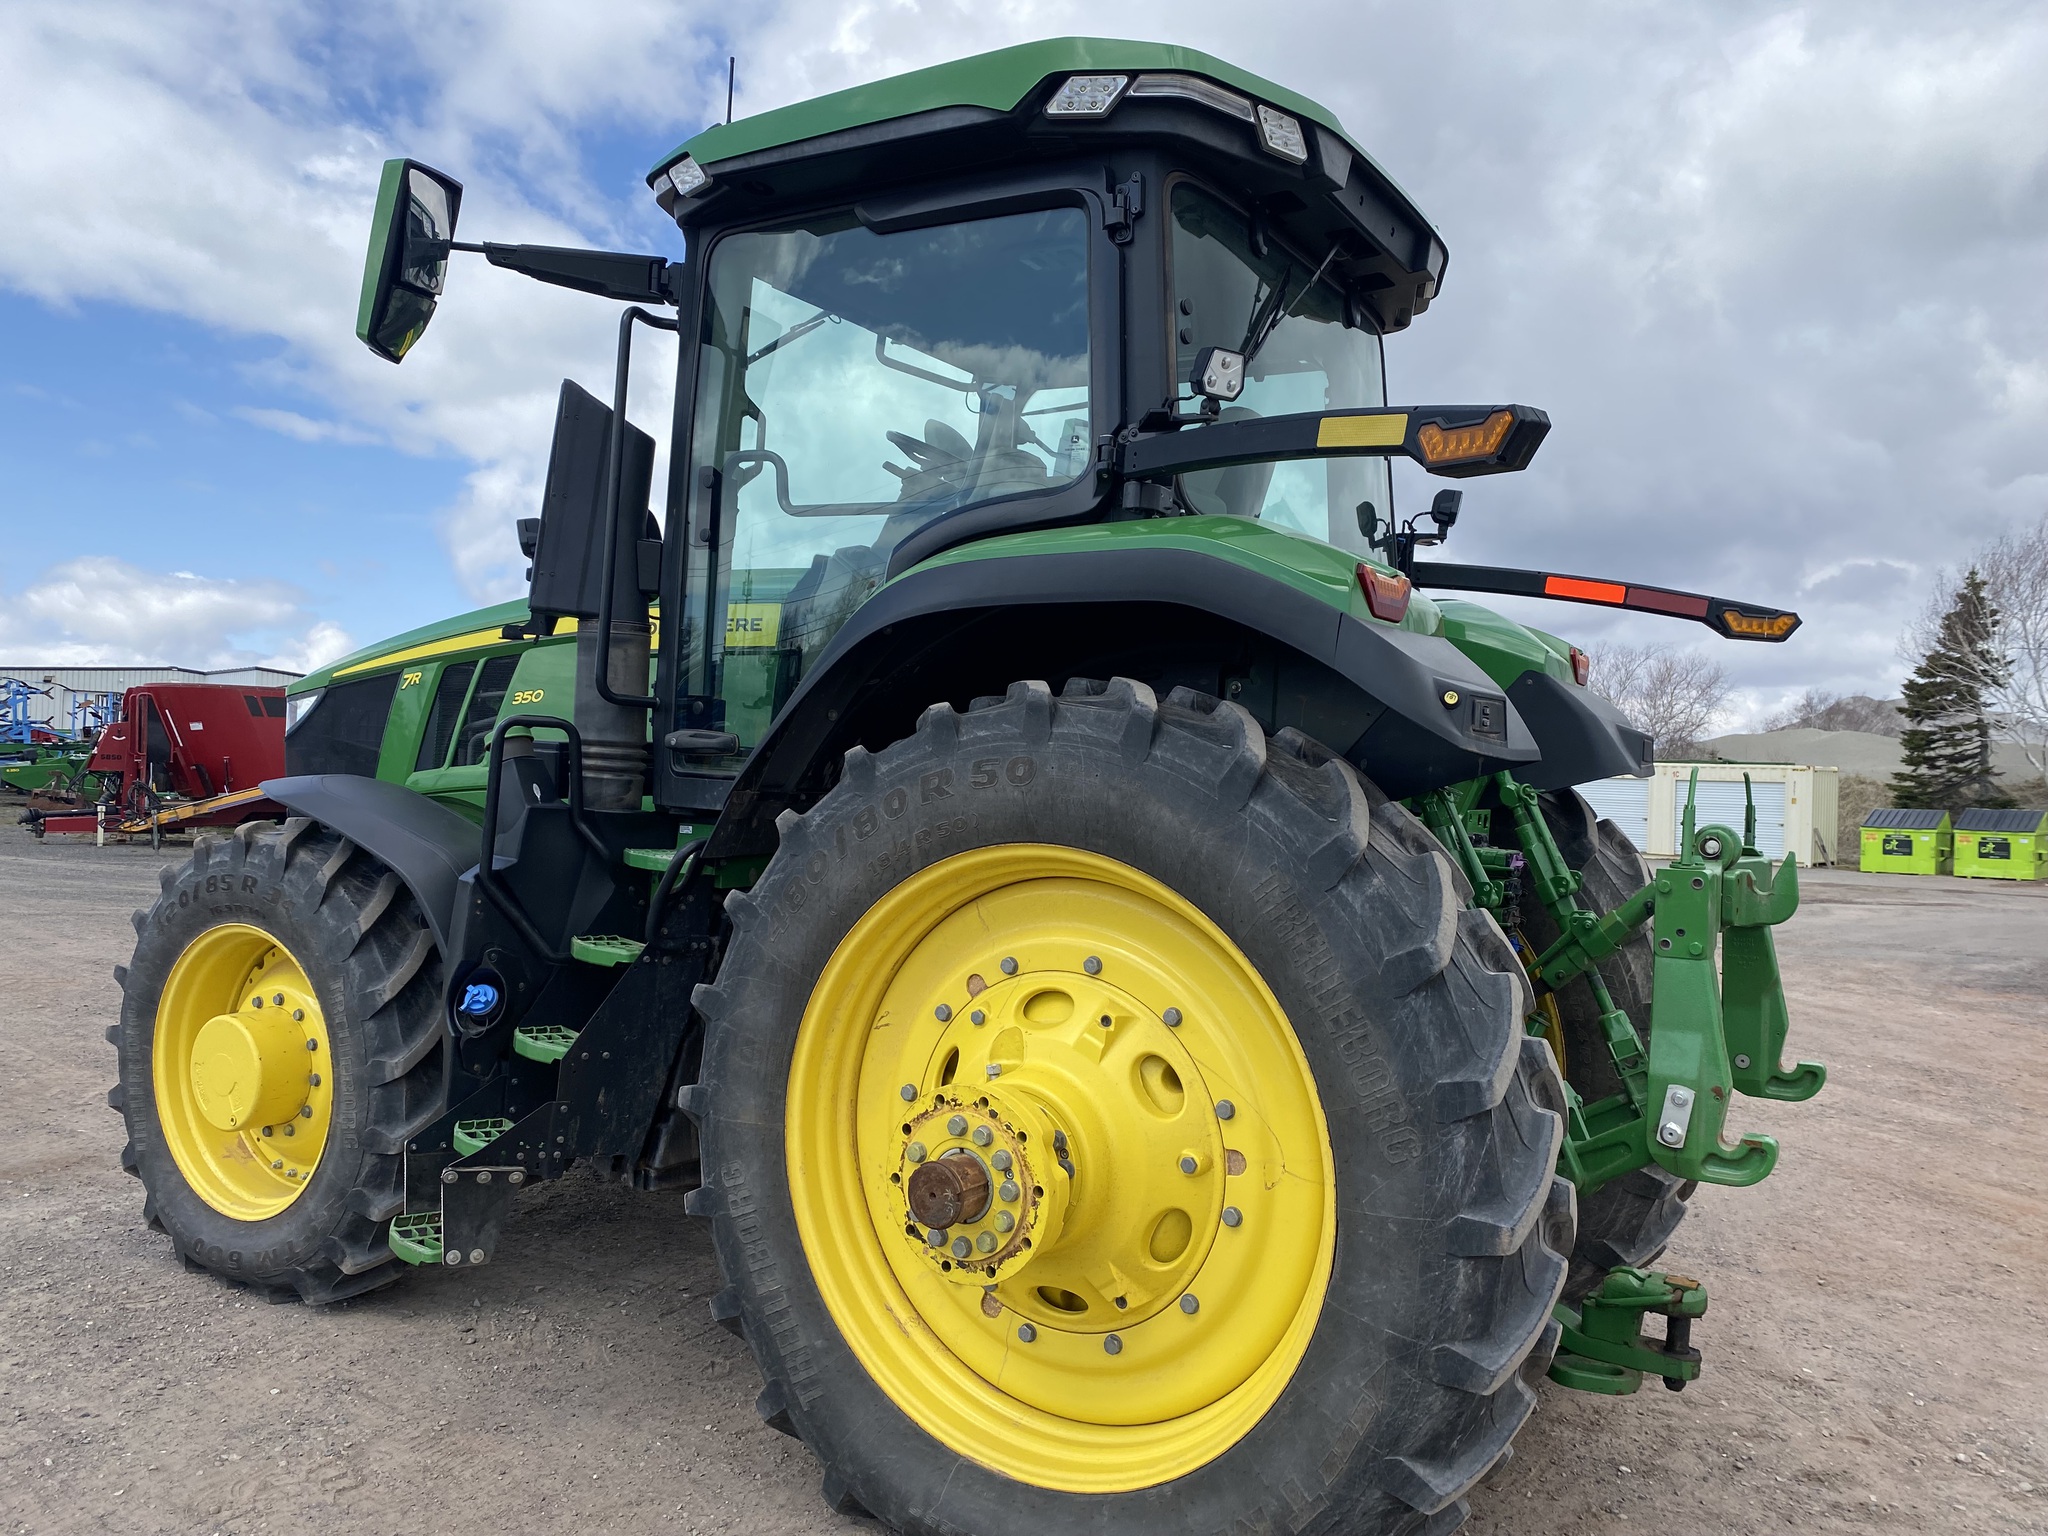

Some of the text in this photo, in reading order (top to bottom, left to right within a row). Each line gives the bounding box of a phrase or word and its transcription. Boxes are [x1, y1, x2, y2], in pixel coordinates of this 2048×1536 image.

[726, 617, 763, 632] ERE
[401, 671, 422, 690] 7R
[511, 689, 545, 706] 350
[969, 755, 1039, 790] 50
[1251, 862, 1423, 1166] TRELLEBORG
